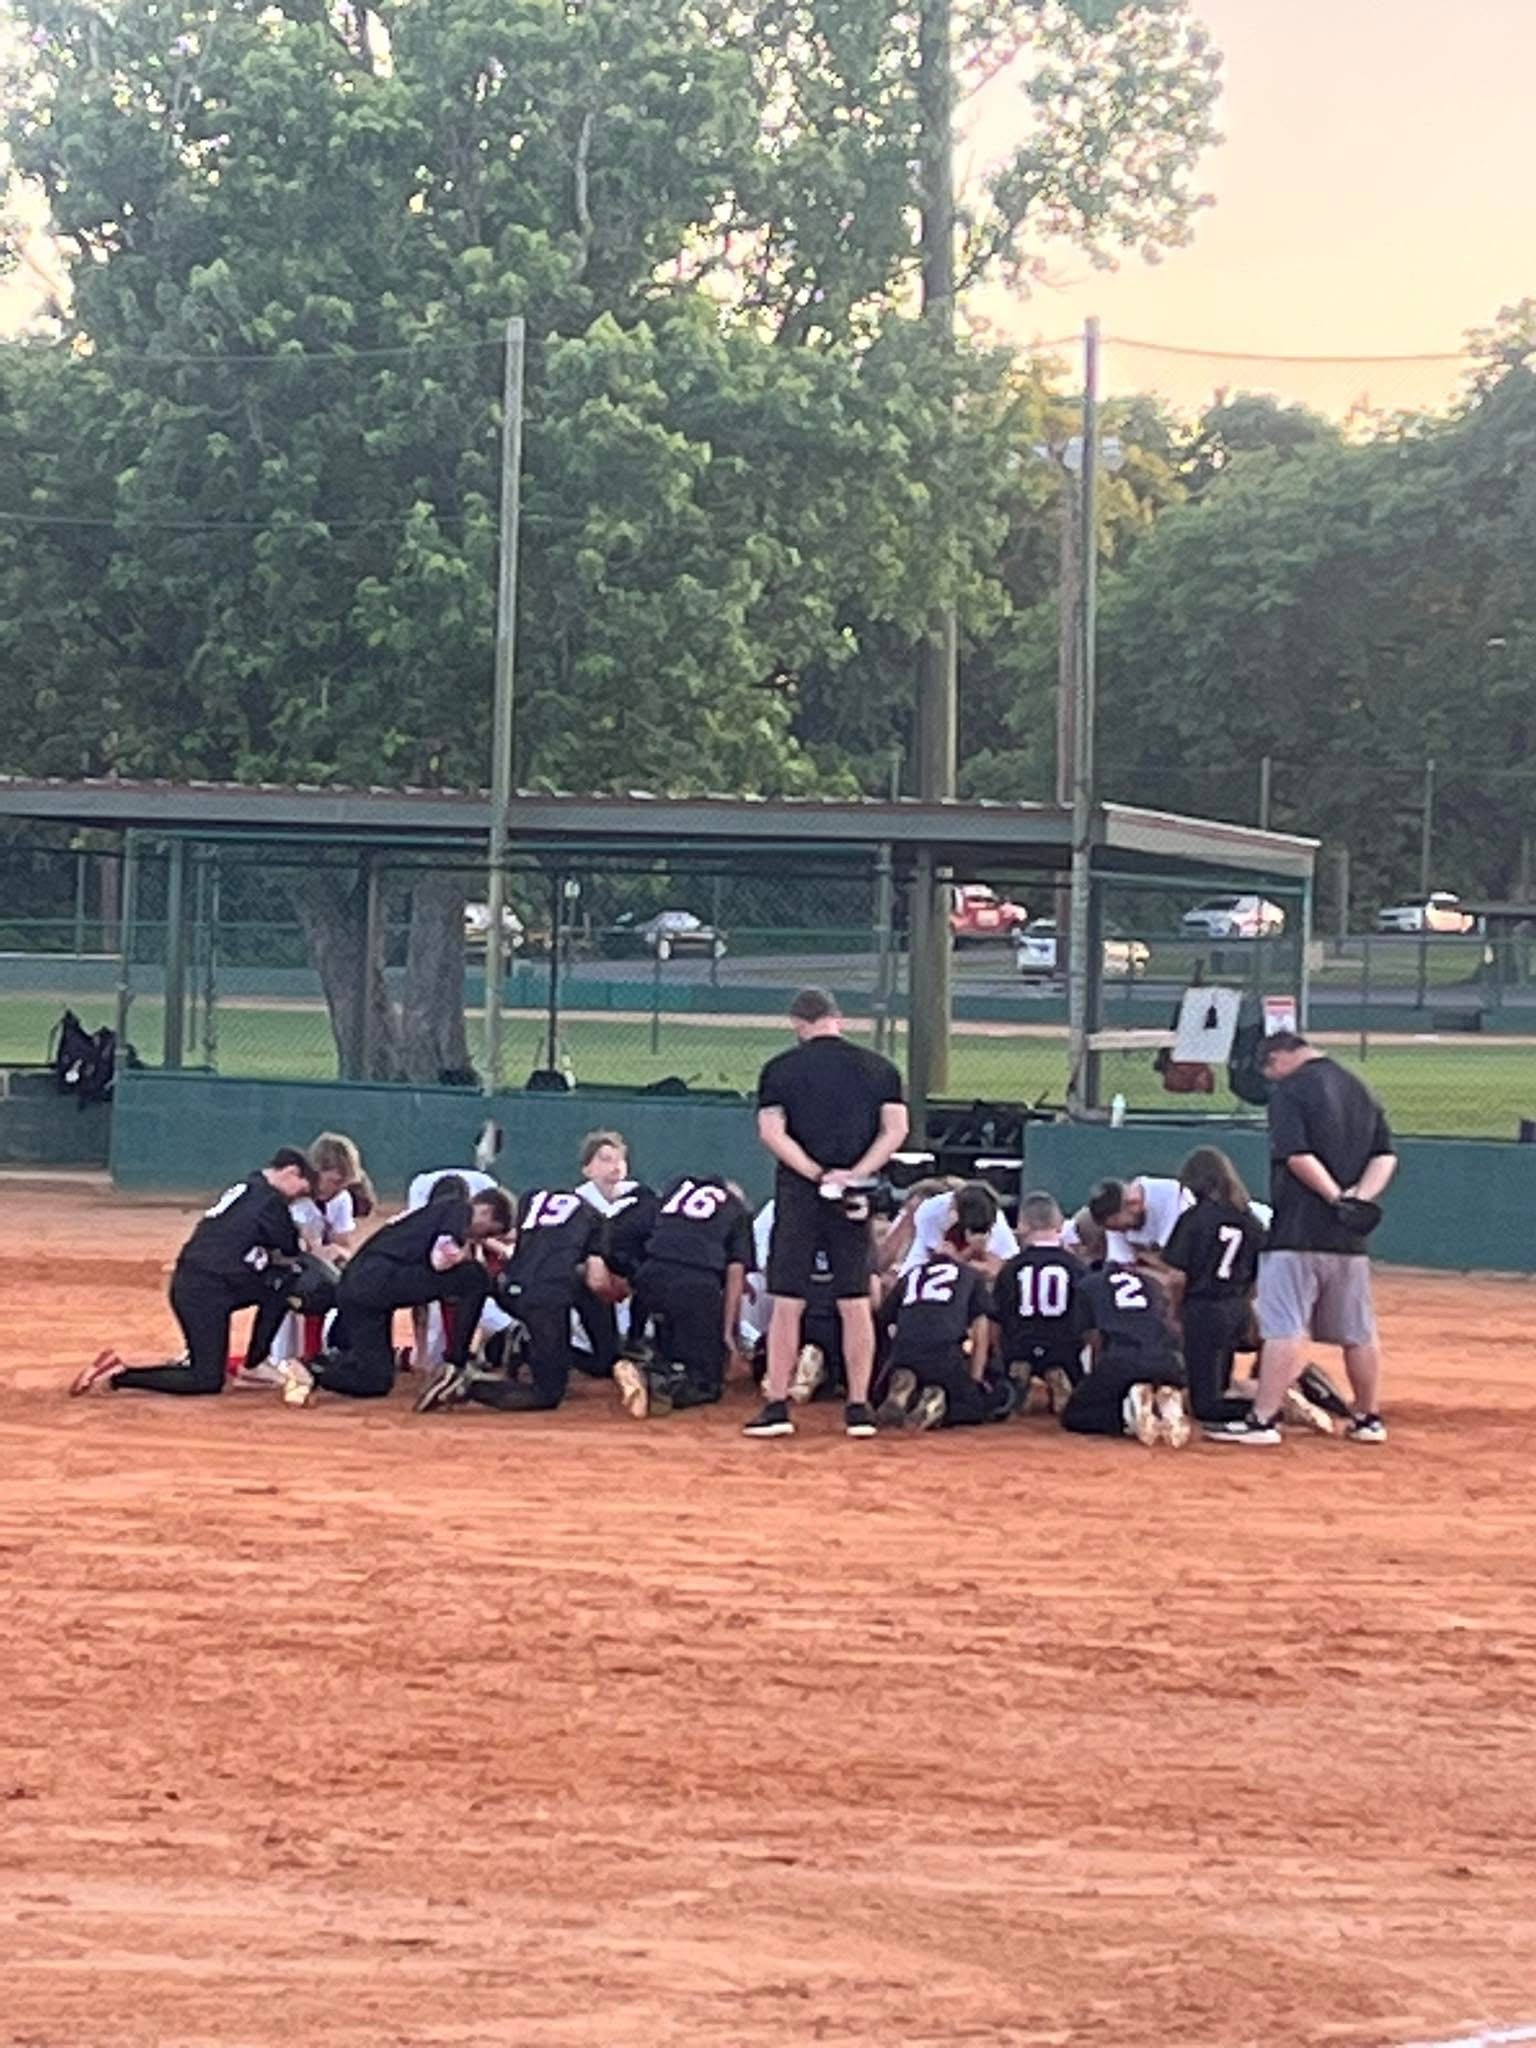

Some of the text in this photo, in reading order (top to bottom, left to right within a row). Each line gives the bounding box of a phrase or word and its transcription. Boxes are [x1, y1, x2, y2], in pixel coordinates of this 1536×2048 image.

[521, 1190, 582, 1230] 19
[660, 1180, 728, 1220] 16
[1217, 1225, 1244, 1279] 7
[901, 1263, 960, 1307] 12
[1016, 1265, 1071, 1317] 10
[1108, 1273, 1149, 1310] 2
